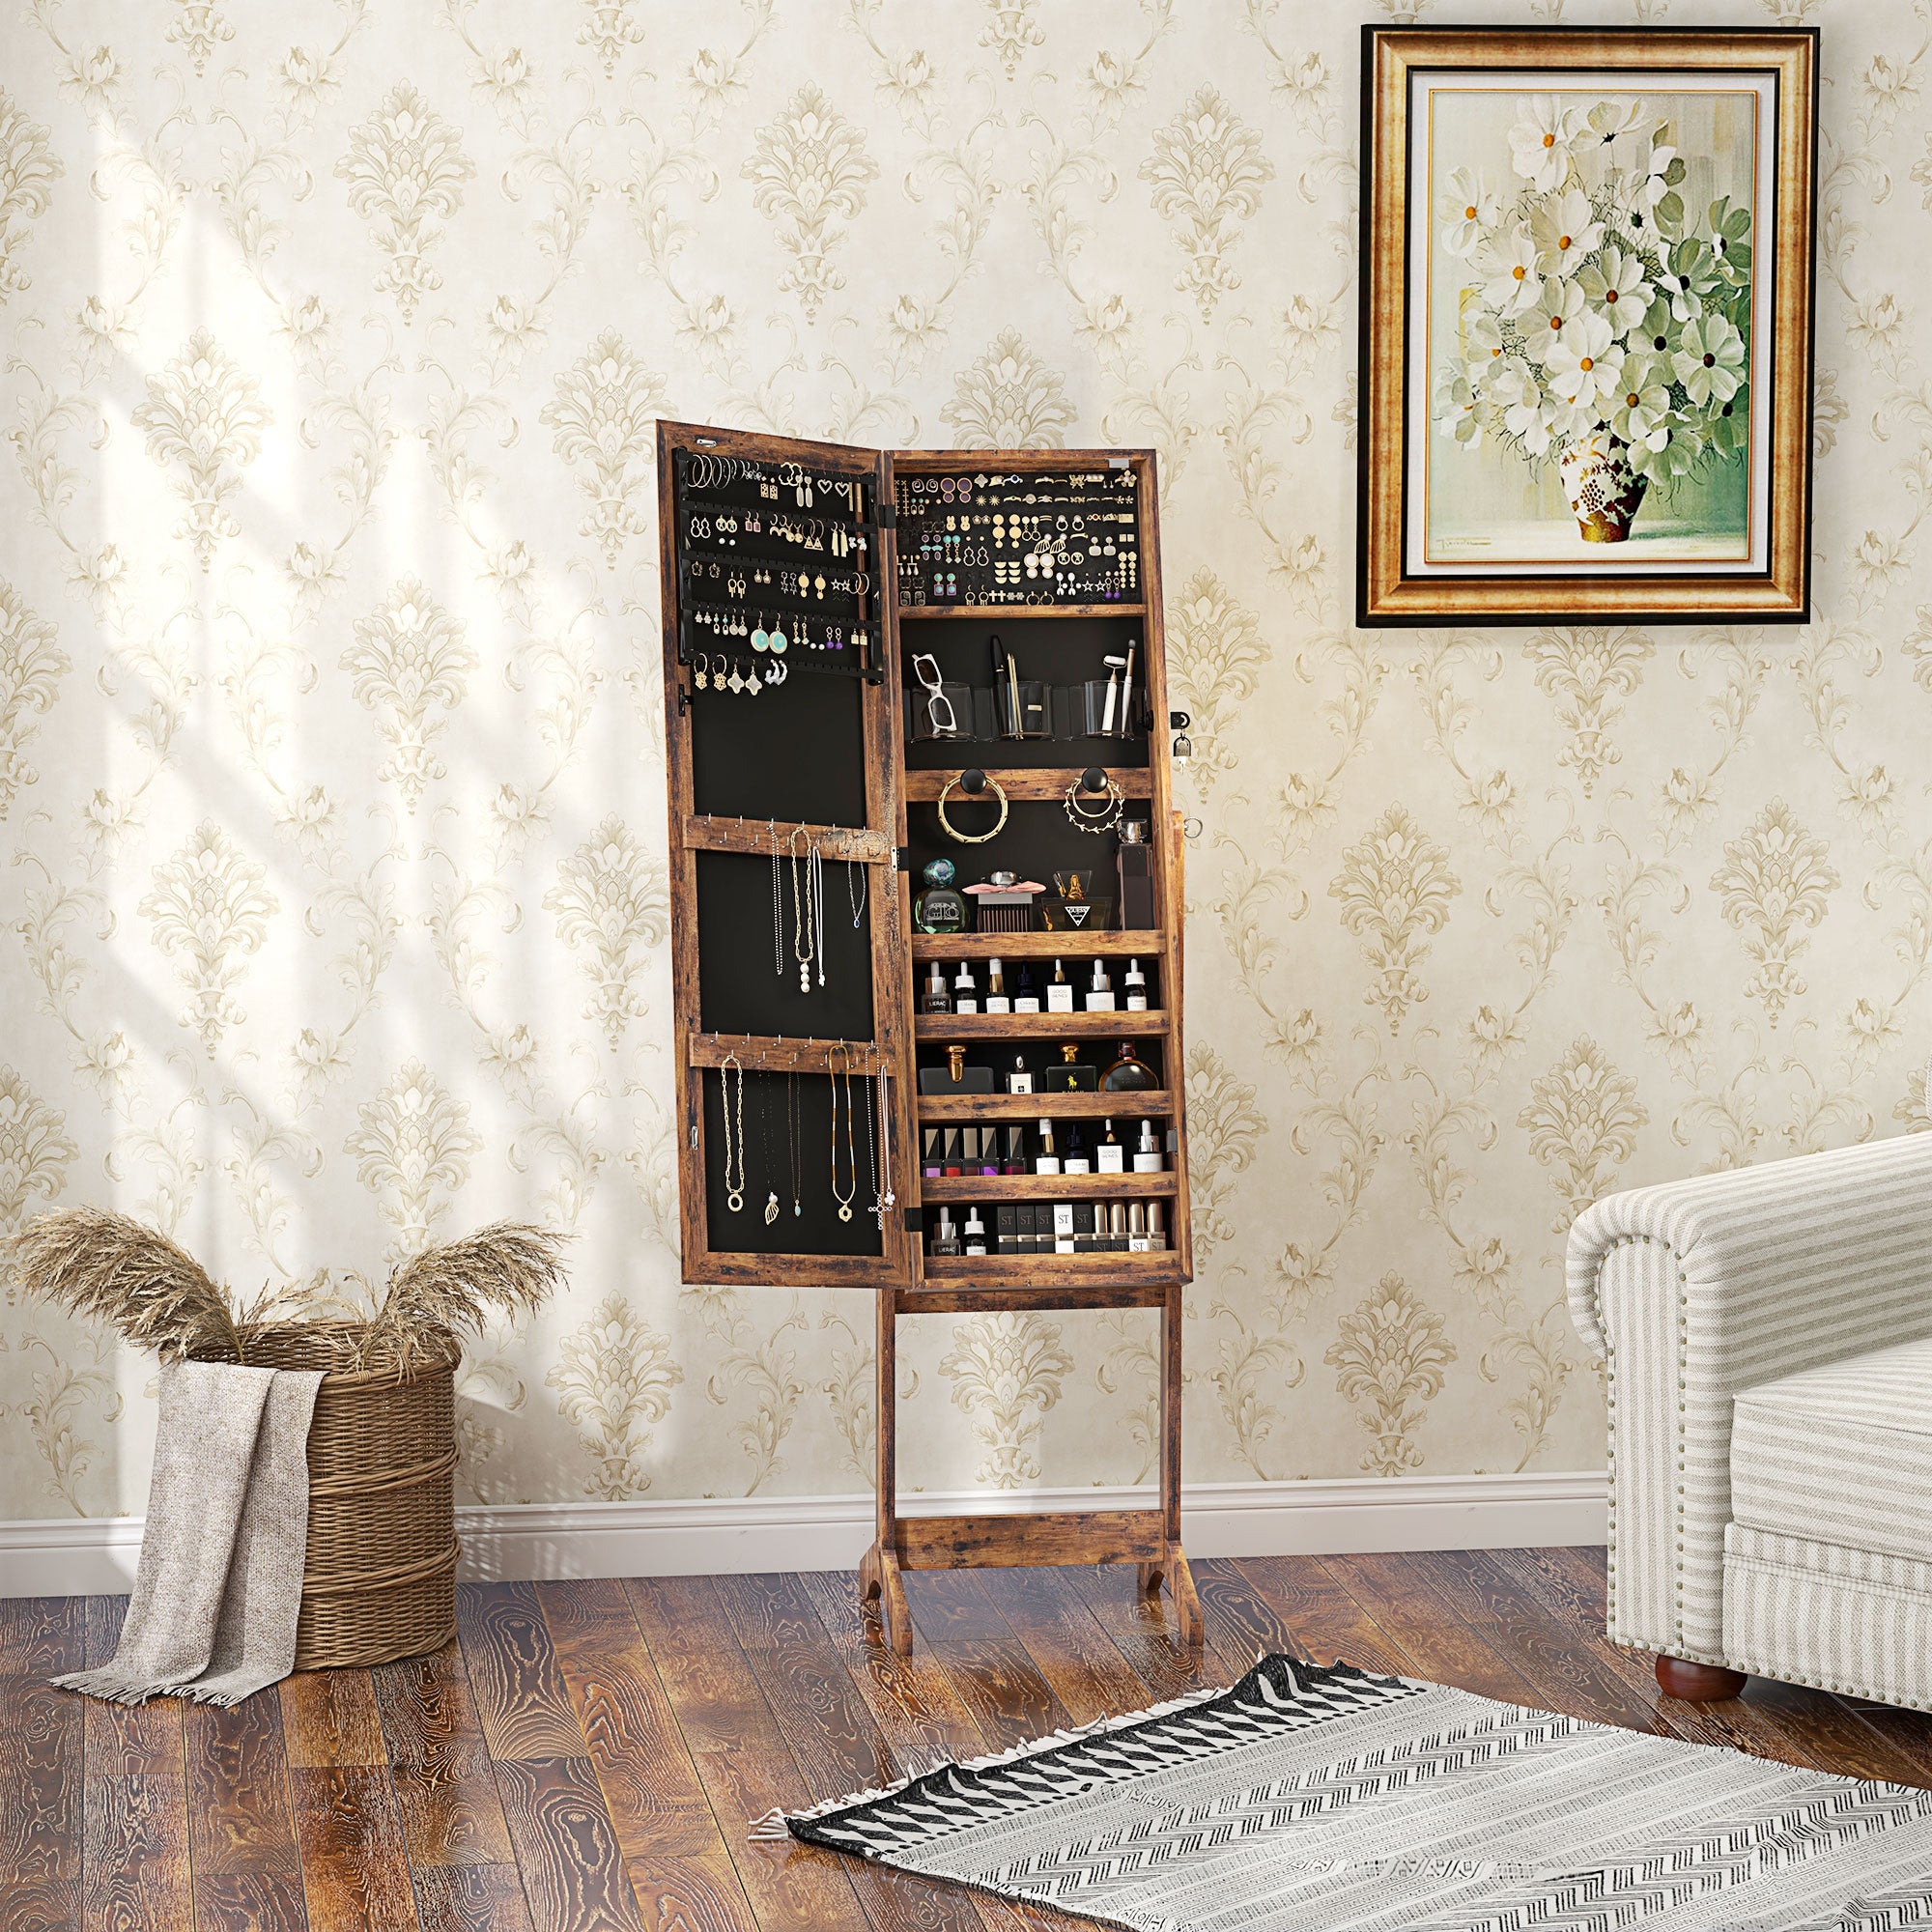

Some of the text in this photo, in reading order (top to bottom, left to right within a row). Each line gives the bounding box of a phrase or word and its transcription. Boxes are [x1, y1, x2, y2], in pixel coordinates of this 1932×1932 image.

[1001, 1215, 1013, 1226] ST
[1020, 1215, 1033, 1225] ST
[1038, 1214, 1051, 1225] ST
[1058, 1214, 1069, 1225] ST
[1077, 1213, 1089, 1224] ST
[1096, 1242, 1108, 1252] ST
[1115, 1242, 1126, 1252] ST
[1133, 1242, 1145, 1252] ST
[1151, 1241, 1163, 1251] ST
